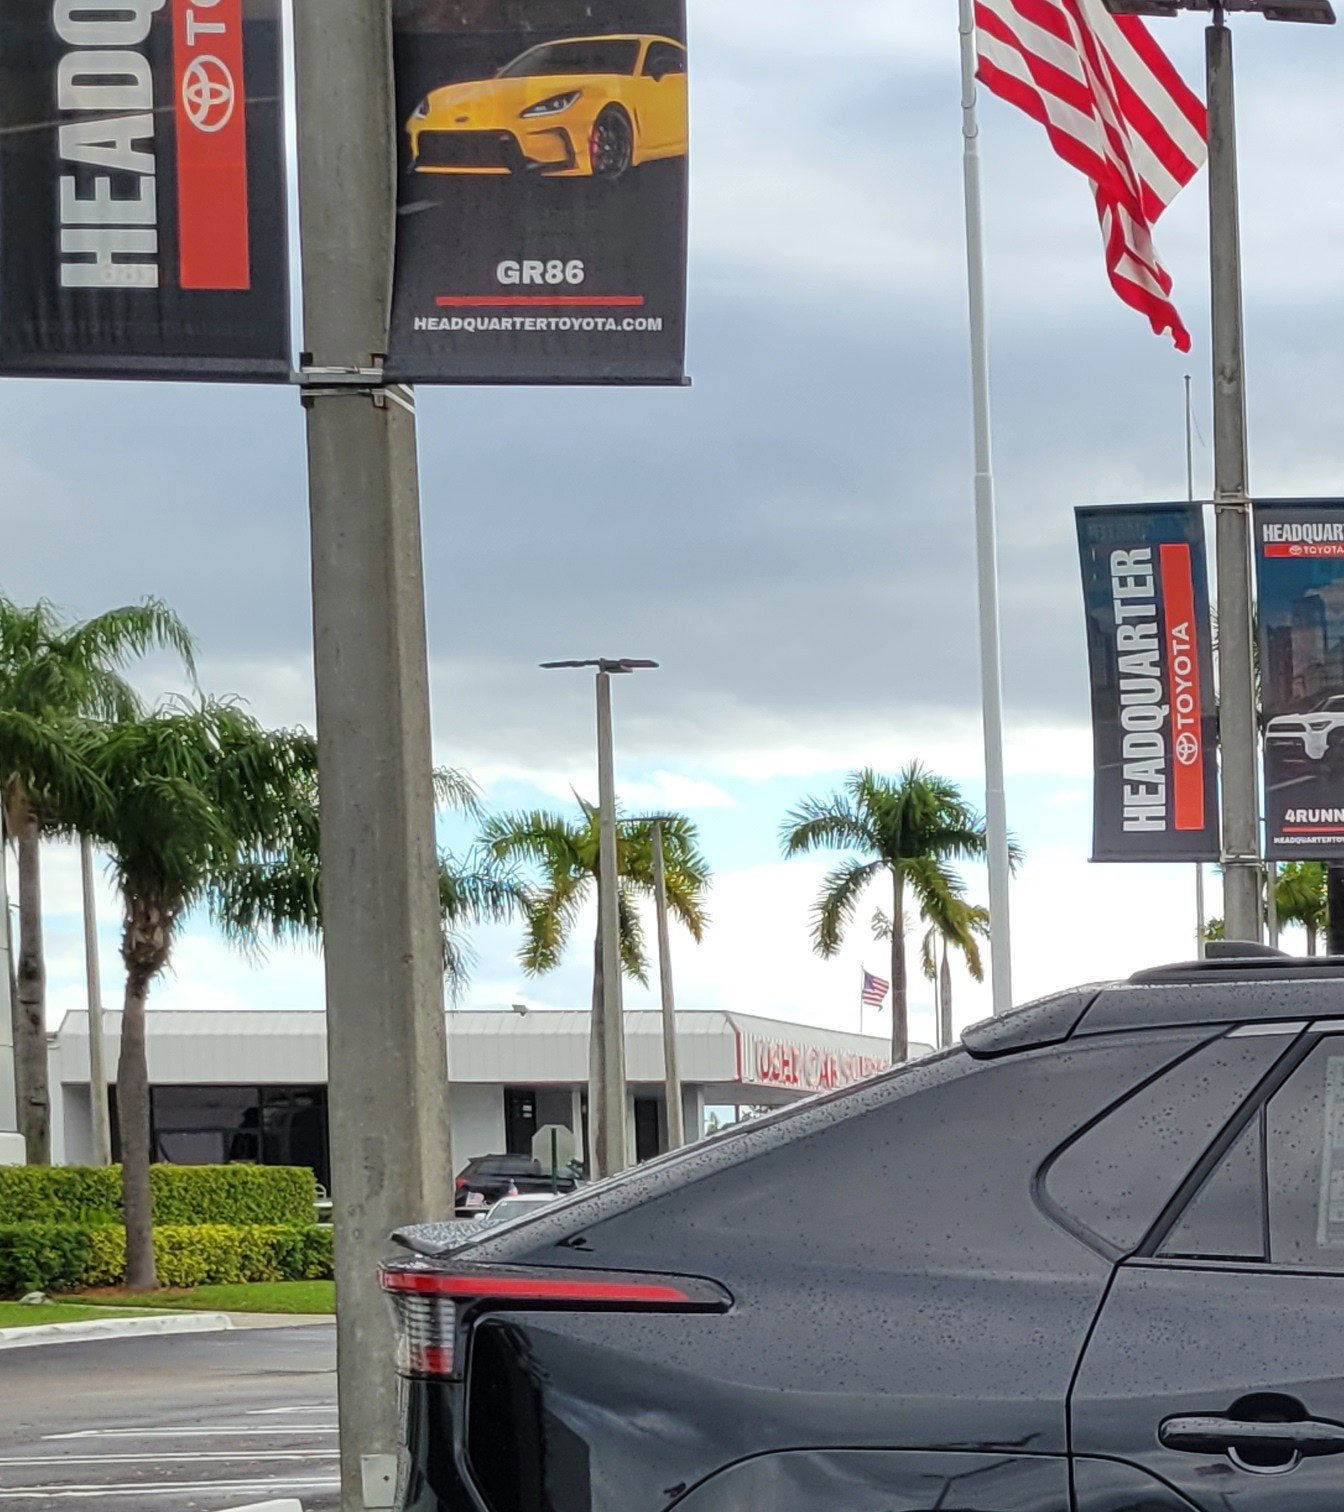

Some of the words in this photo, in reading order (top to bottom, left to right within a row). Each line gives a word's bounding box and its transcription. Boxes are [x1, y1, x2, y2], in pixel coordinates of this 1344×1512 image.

[497, 260, 585, 285] GR86
[414, 317, 663, 332] HEADQUARTERTOYOTA.COM
[1303, 545, 1344, 555] TOYOTA
[1171, 621, 1195, 730] TOYOTA
[1110, 547, 1169, 832] HEADQUARTER
